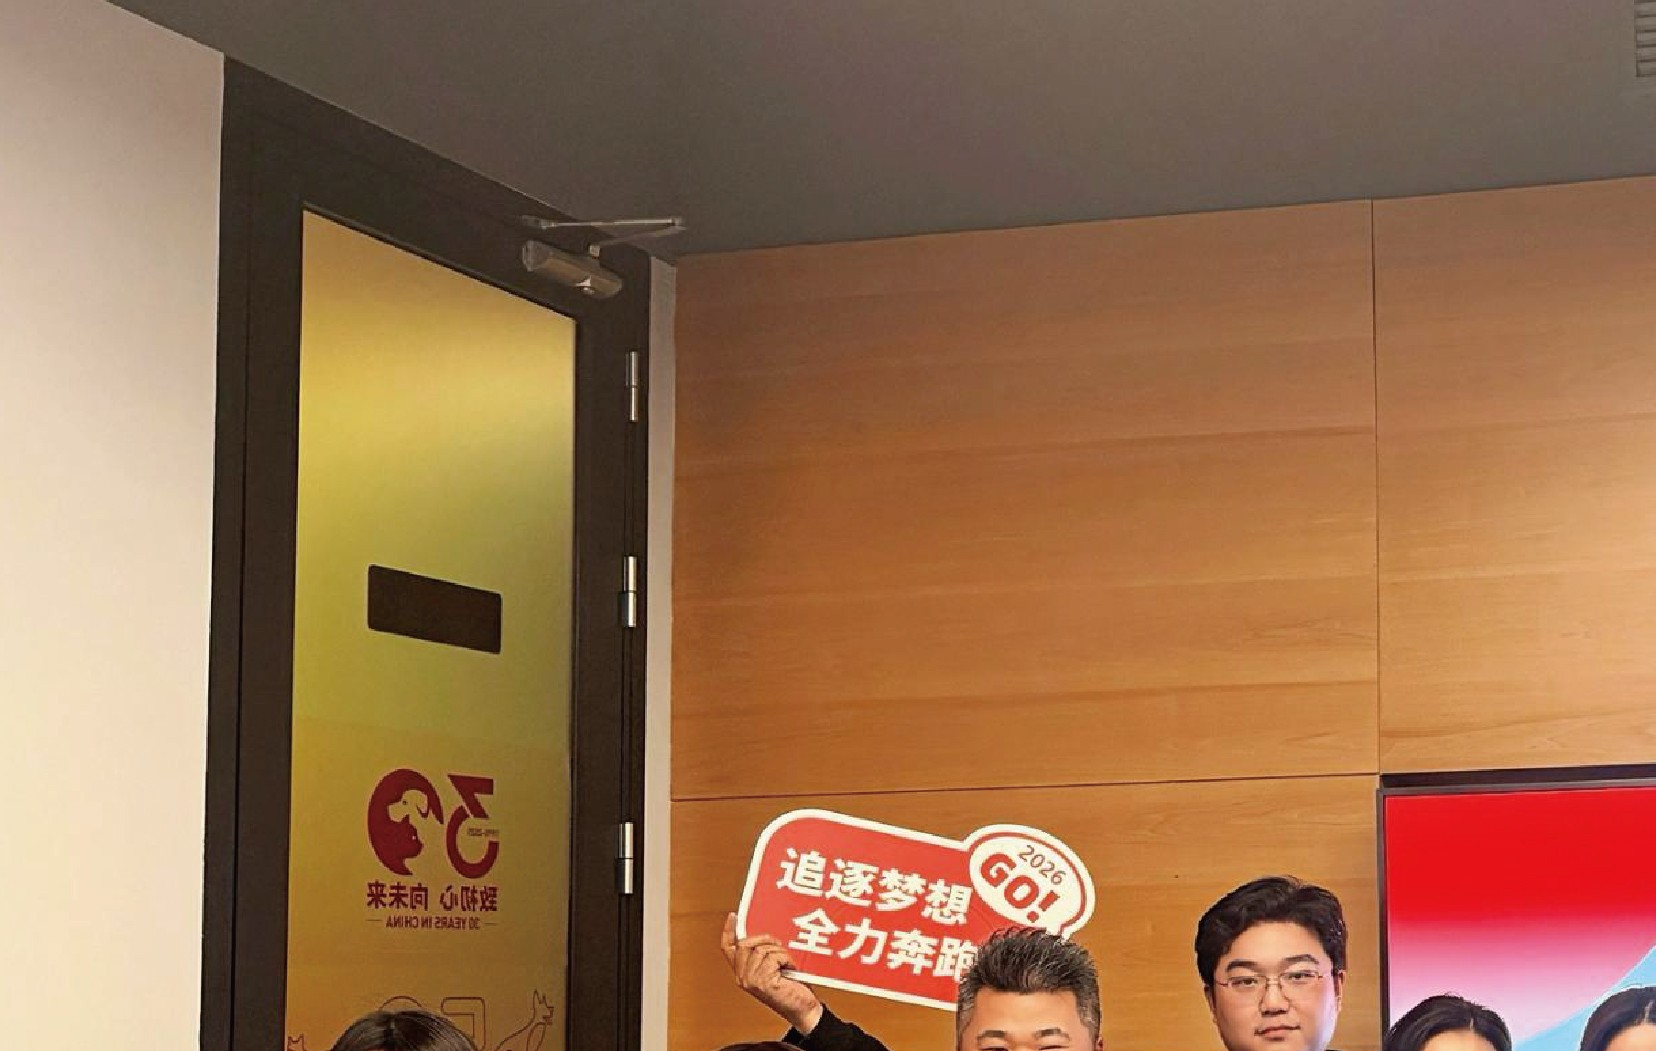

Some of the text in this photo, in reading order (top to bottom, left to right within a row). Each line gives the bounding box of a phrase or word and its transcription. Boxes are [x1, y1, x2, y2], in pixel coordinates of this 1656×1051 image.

[776, 848, 973, 925] 追逐梦想
[980, 852, 1061, 923] GO!
[1017, 844, 1066, 886] 2026
